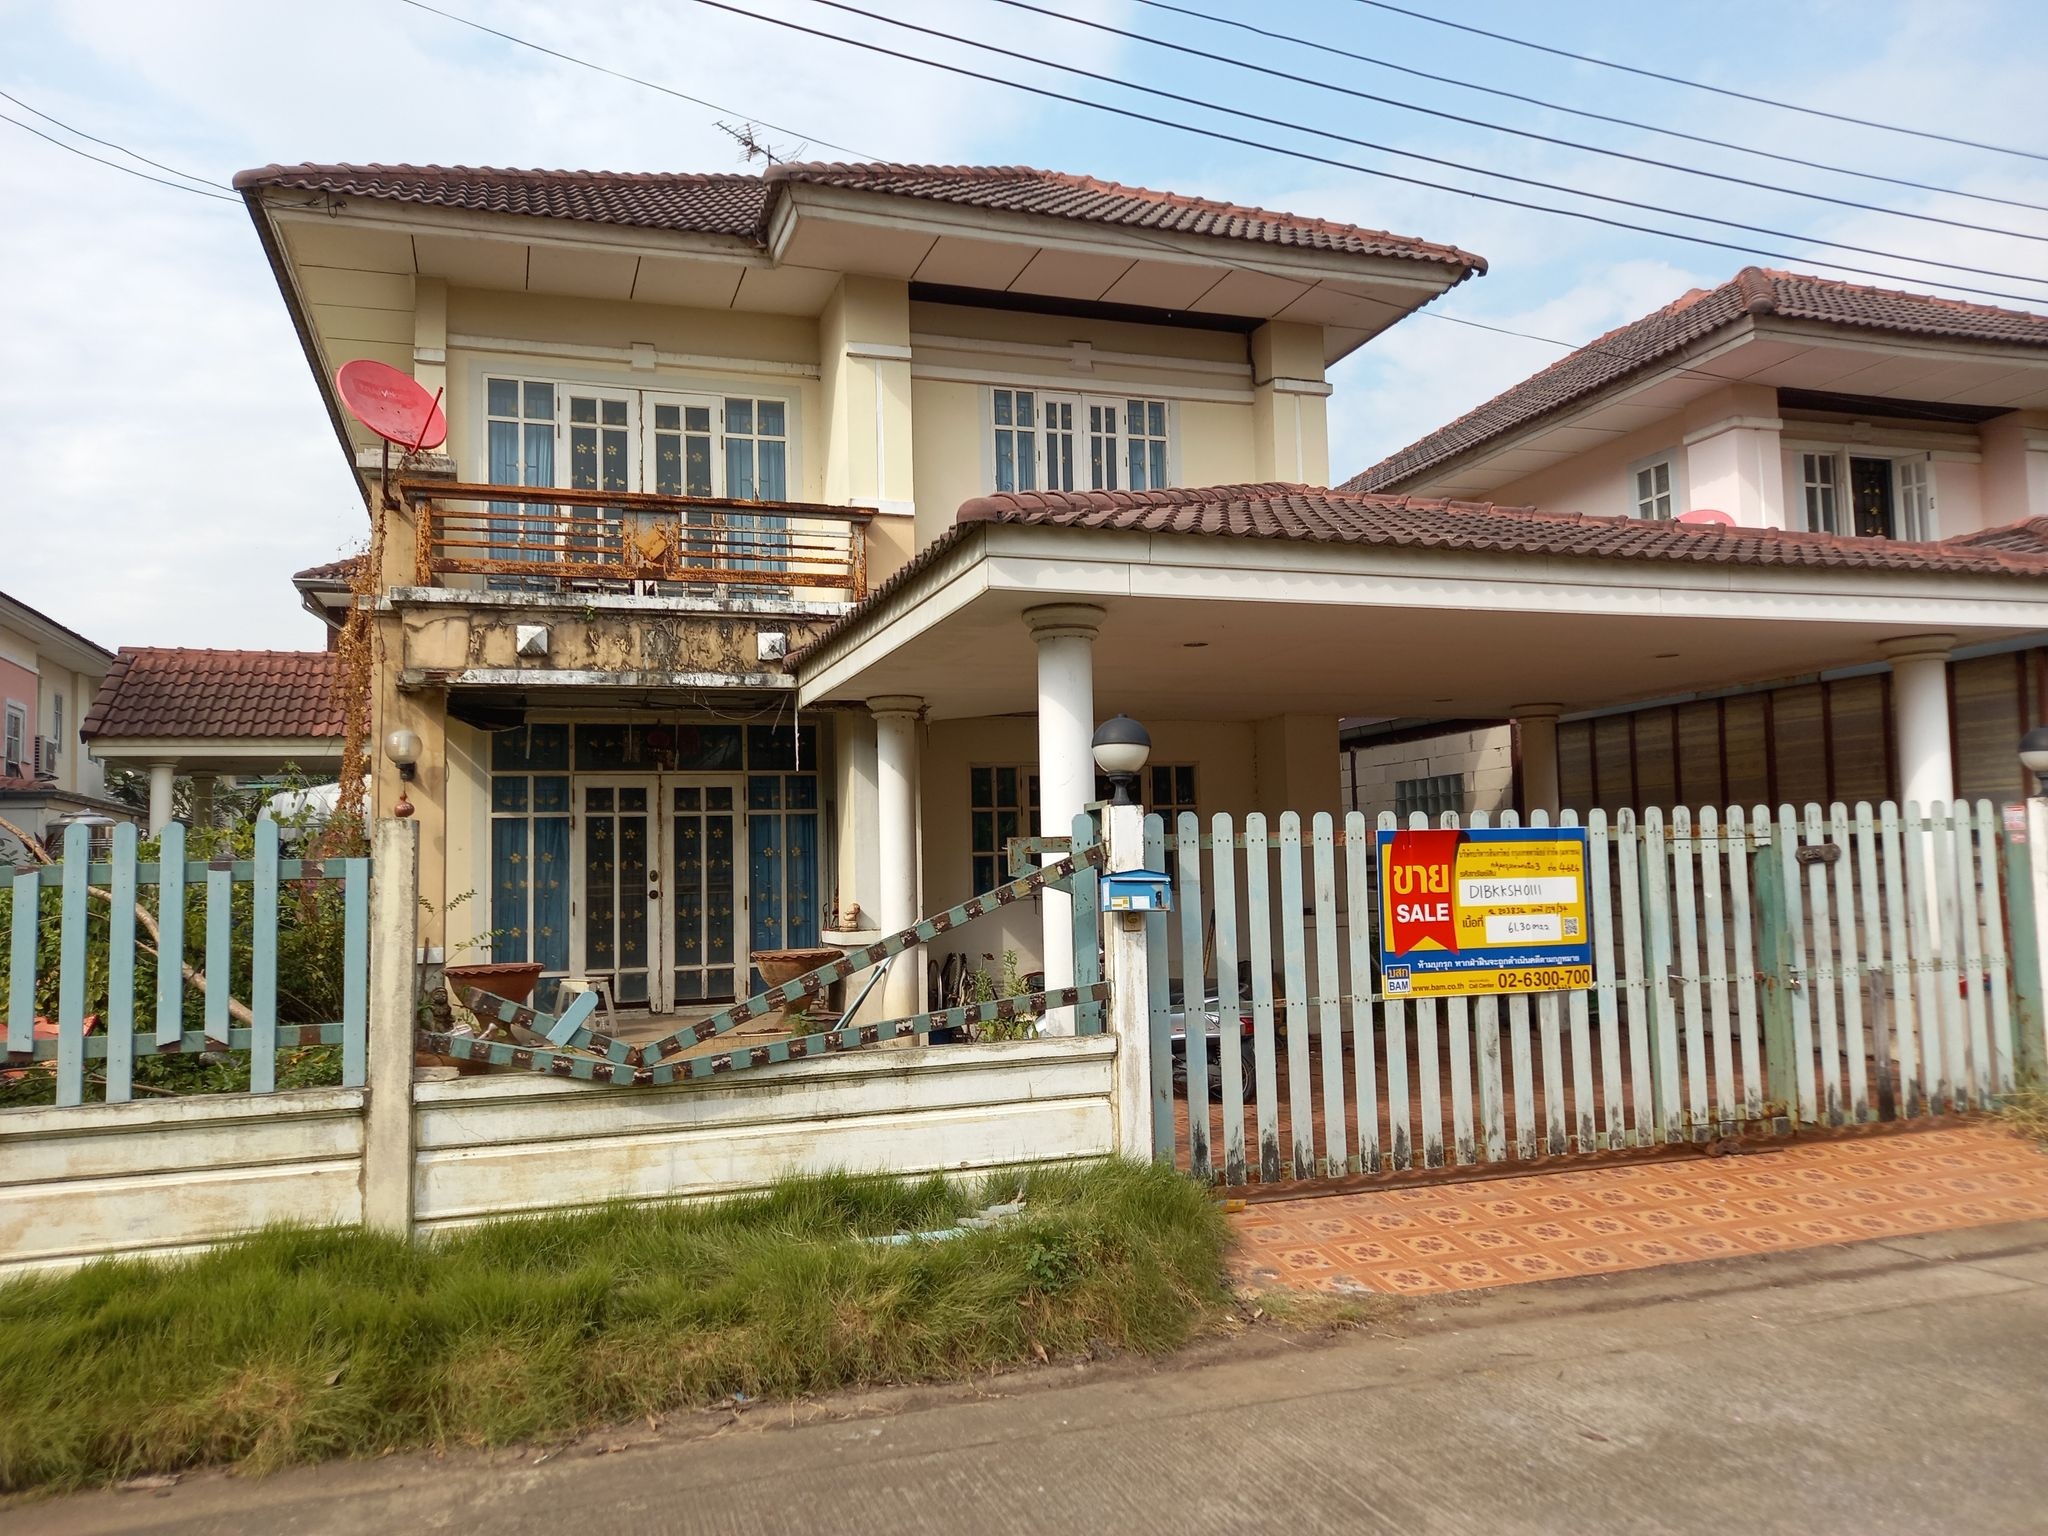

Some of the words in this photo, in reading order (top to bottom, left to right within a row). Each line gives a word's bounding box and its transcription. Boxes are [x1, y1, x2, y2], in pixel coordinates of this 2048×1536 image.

[1393, 864, 1450, 895] ขาย
[1396, 902, 1450, 923] SALE
[1462, 915, 1484, 928] เนื้อที่
[1417, 959, 1453, 971] ห้ามบุกรุก
[1388, 967, 1409, 978] บสก
[1498, 969, 1590, 988] 02-6300-700
[1389, 980, 1409, 991] BAM
[1411, 983, 1465, 992] www.bam.co.th
